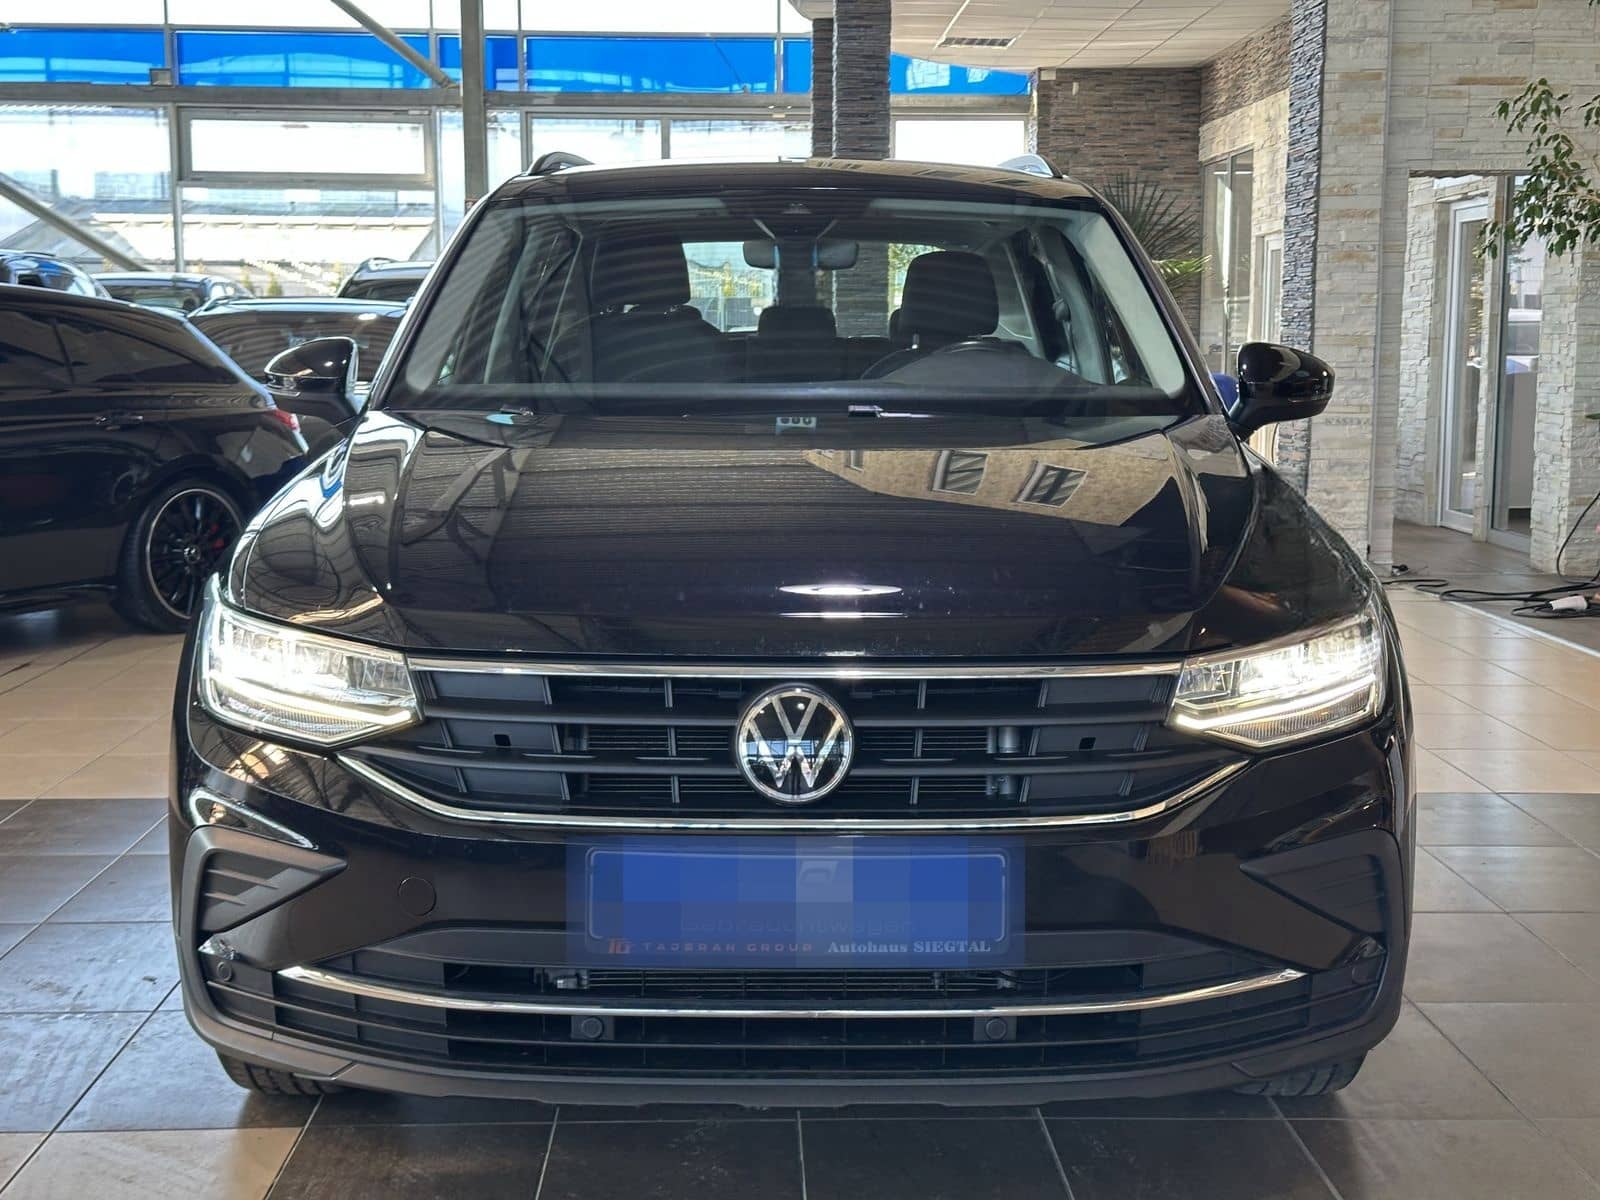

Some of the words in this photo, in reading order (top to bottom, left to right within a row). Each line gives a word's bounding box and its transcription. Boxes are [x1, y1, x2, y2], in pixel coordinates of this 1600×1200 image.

[746, 942, 813, 953] GROUP
[827, 941, 908, 953] Autohaus
[913, 940, 992, 953] SIEGTAL
